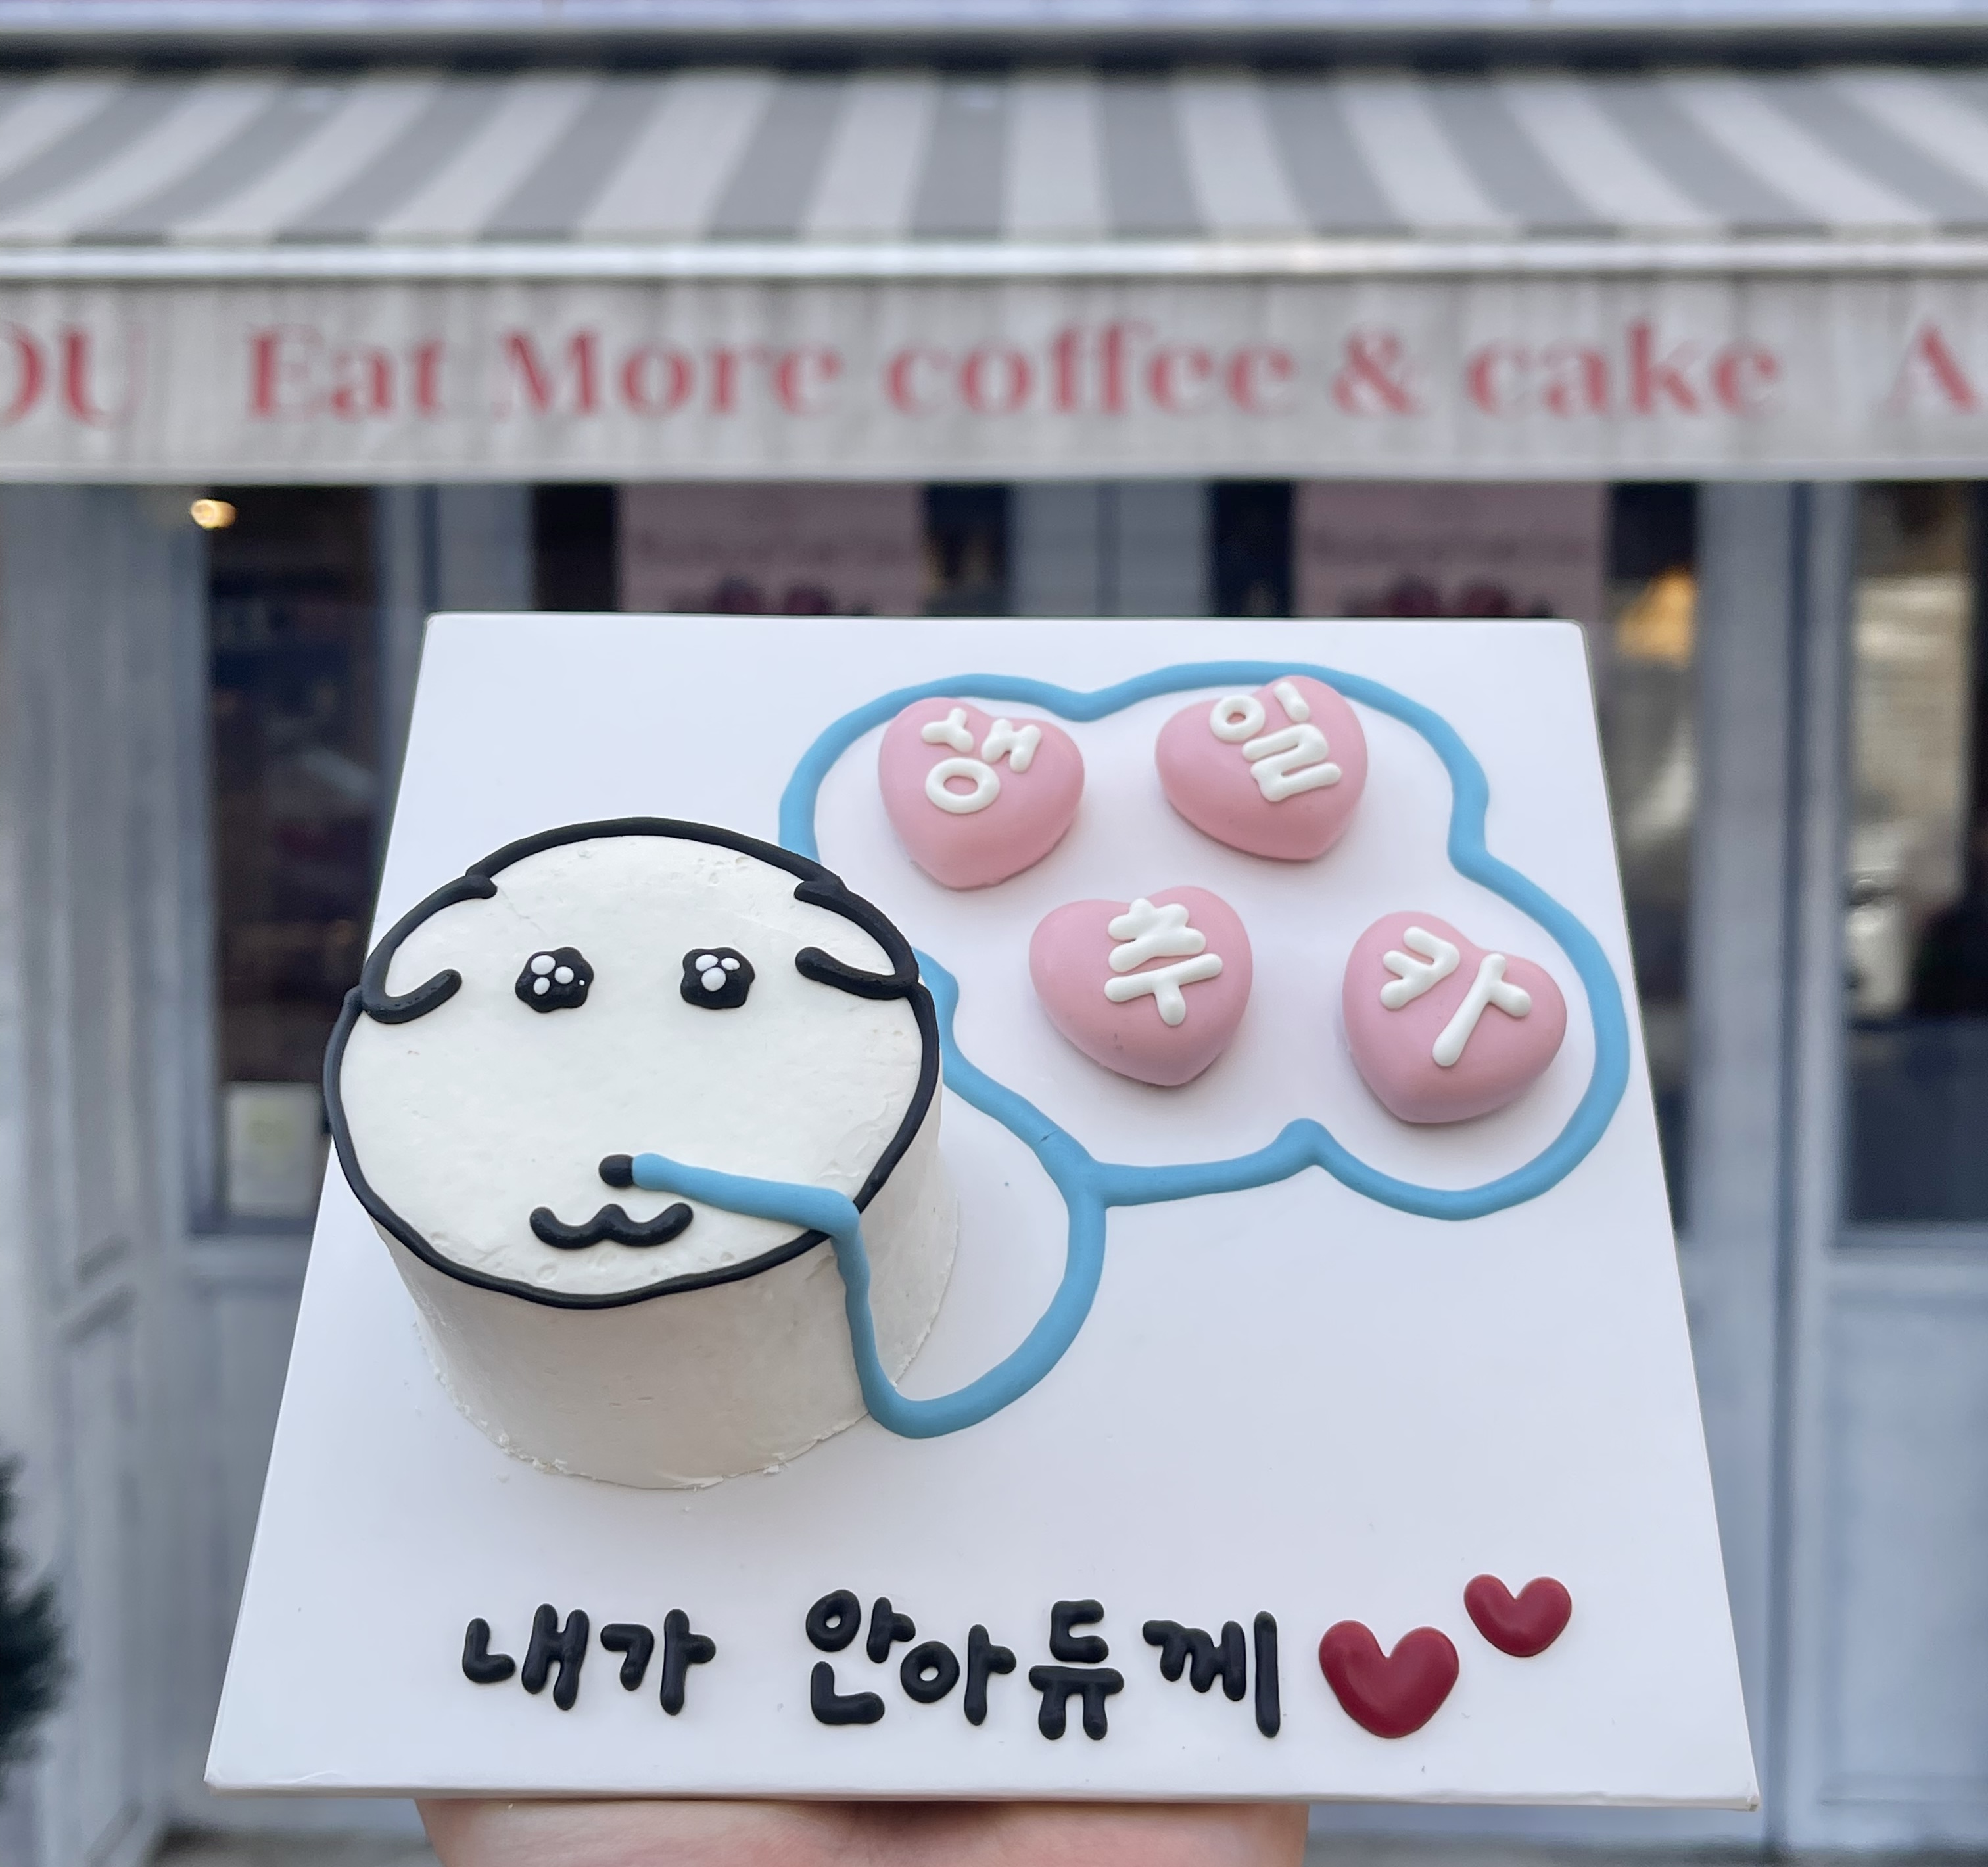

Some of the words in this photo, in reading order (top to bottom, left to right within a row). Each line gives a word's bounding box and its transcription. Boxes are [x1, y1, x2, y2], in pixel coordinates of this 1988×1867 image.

[246, 325, 448, 422] Eat
[490, 325, 847, 421] More
[881, 317, 1299, 418] coffee
[1329, 329, 1424, 419] &
[1463, 317, 1783, 419] cake
[462, 1603, 717, 1716] 내가
